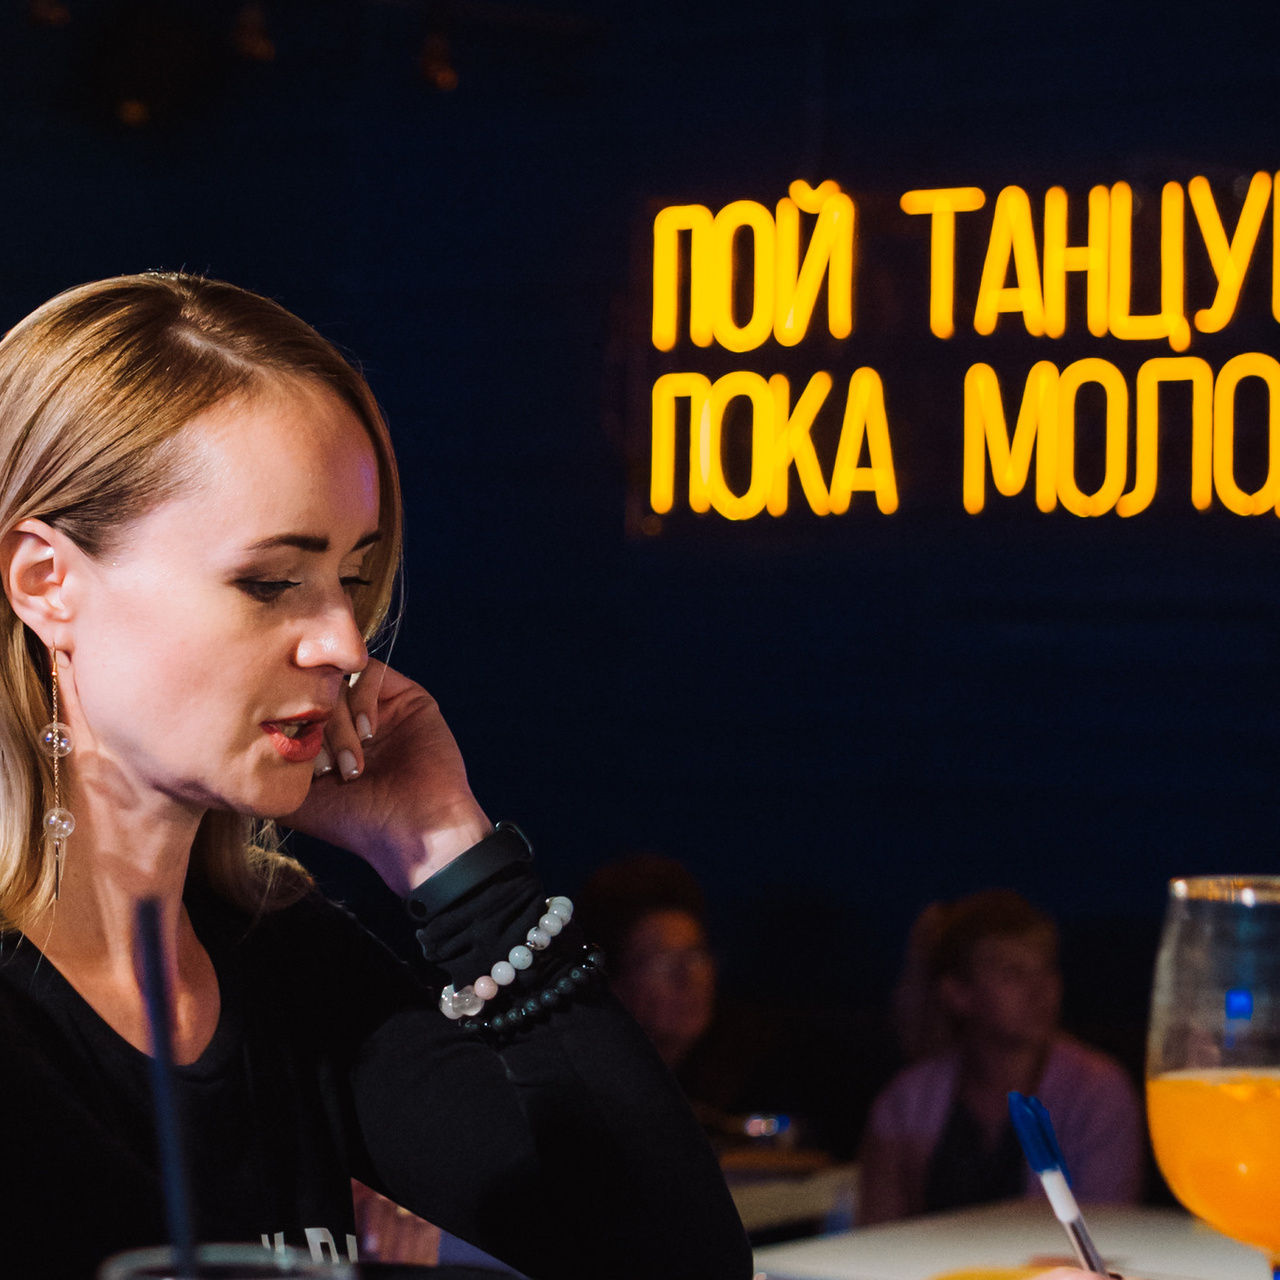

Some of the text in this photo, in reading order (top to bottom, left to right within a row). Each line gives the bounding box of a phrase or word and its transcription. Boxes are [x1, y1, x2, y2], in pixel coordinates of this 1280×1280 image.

[651, 170, 1280, 354] ПОЙ ТАНЦУ
[649, 351, 1280, 520] ПОКА МОЛО
